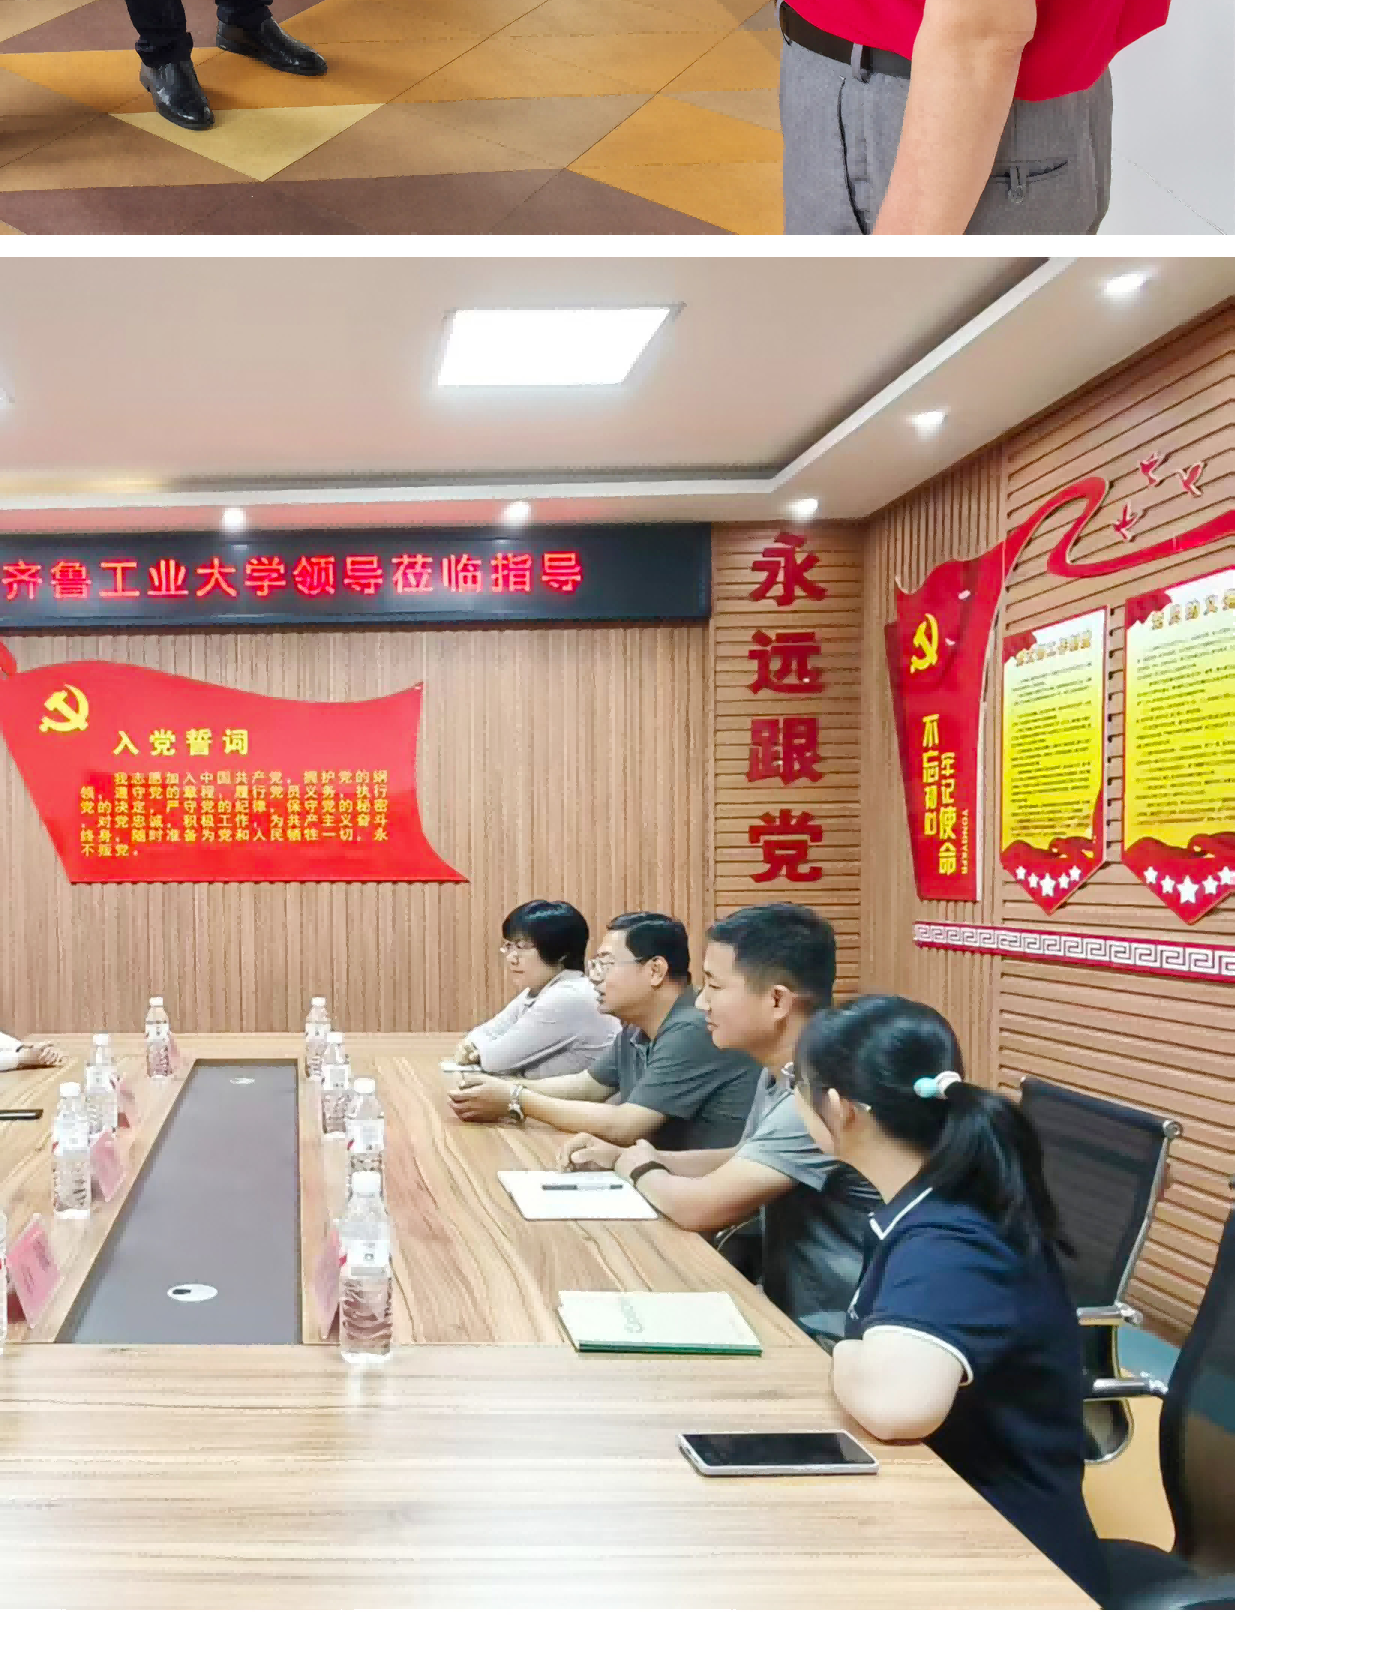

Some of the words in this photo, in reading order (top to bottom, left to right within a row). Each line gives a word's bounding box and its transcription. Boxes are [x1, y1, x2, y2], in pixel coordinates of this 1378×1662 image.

[113, 728, 251, 757] 入党誓词
[745, 531, 827, 884] 永远跟党
[922, 713, 940, 836] 不忘初心
[939, 751, 958, 876] 牢记使命
